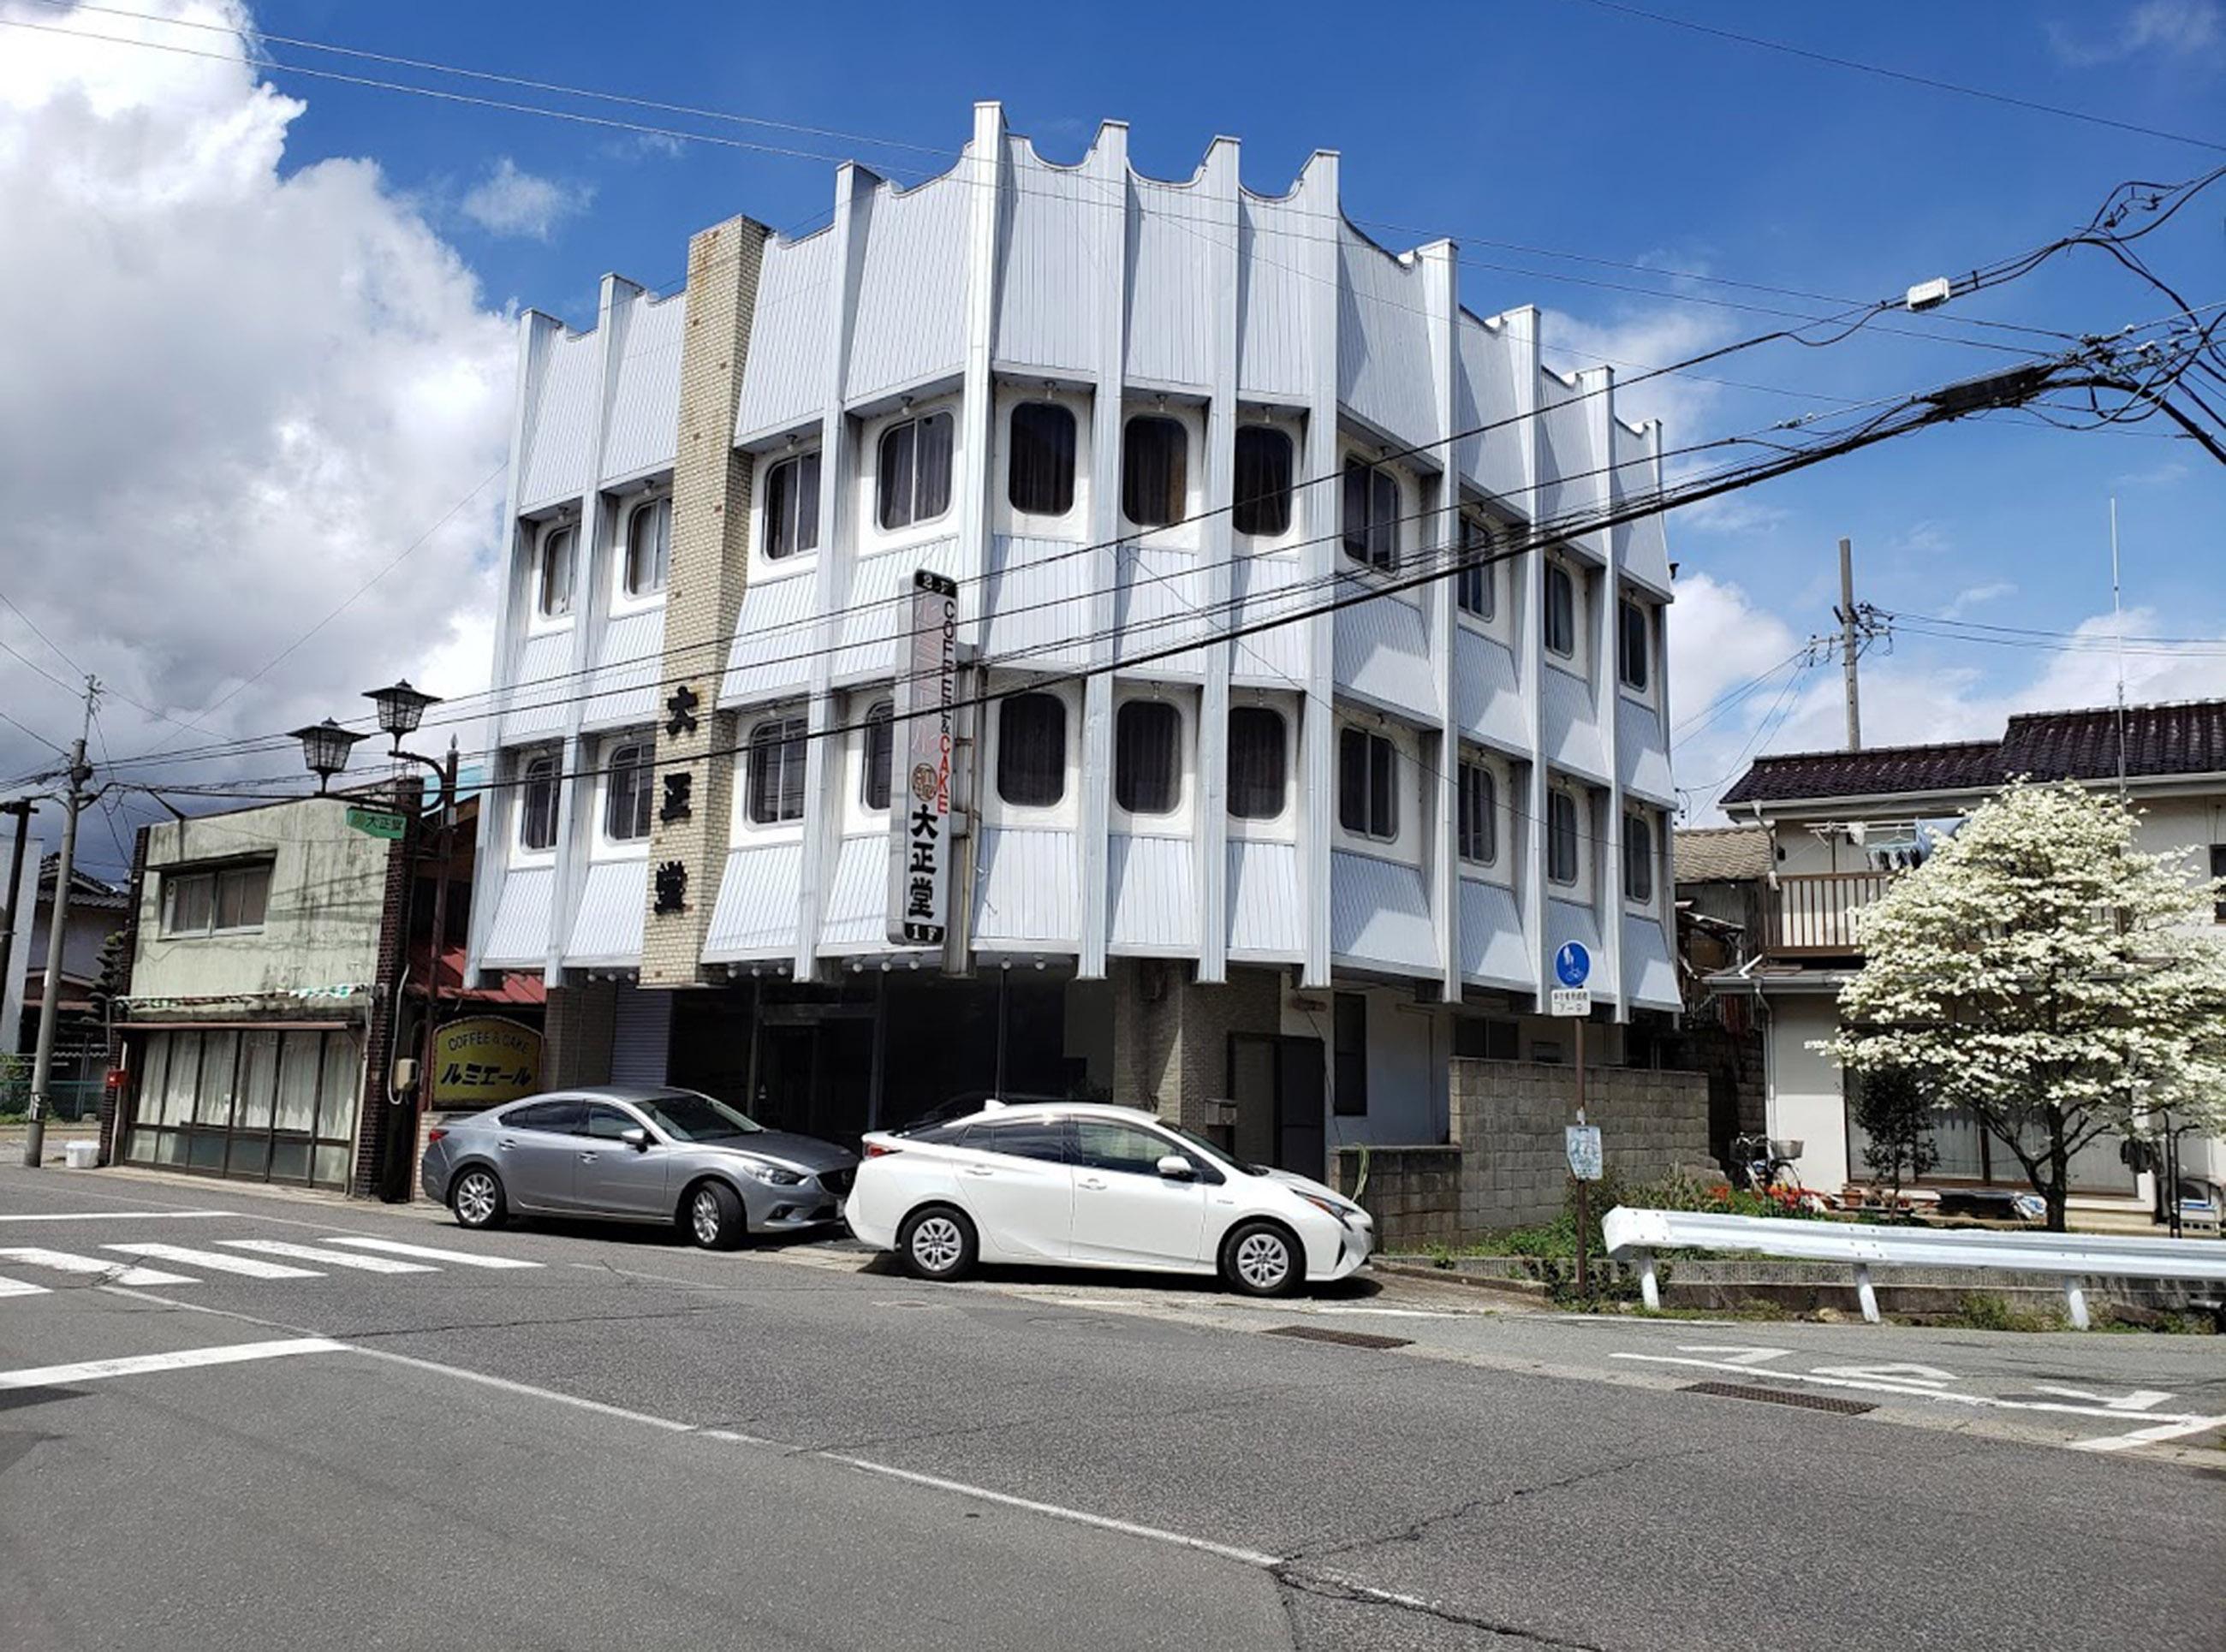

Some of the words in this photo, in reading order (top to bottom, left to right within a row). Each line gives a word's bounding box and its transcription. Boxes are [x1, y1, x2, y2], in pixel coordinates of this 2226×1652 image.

[908, 803, 939, 919] 大正堂
[913, 924, 937, 941] 1F
[448, 1031, 491, 1051] COFFEE
[503, 1034, 530, 1054] CAKE
[440, 1062, 533, 1087] ルミエール
